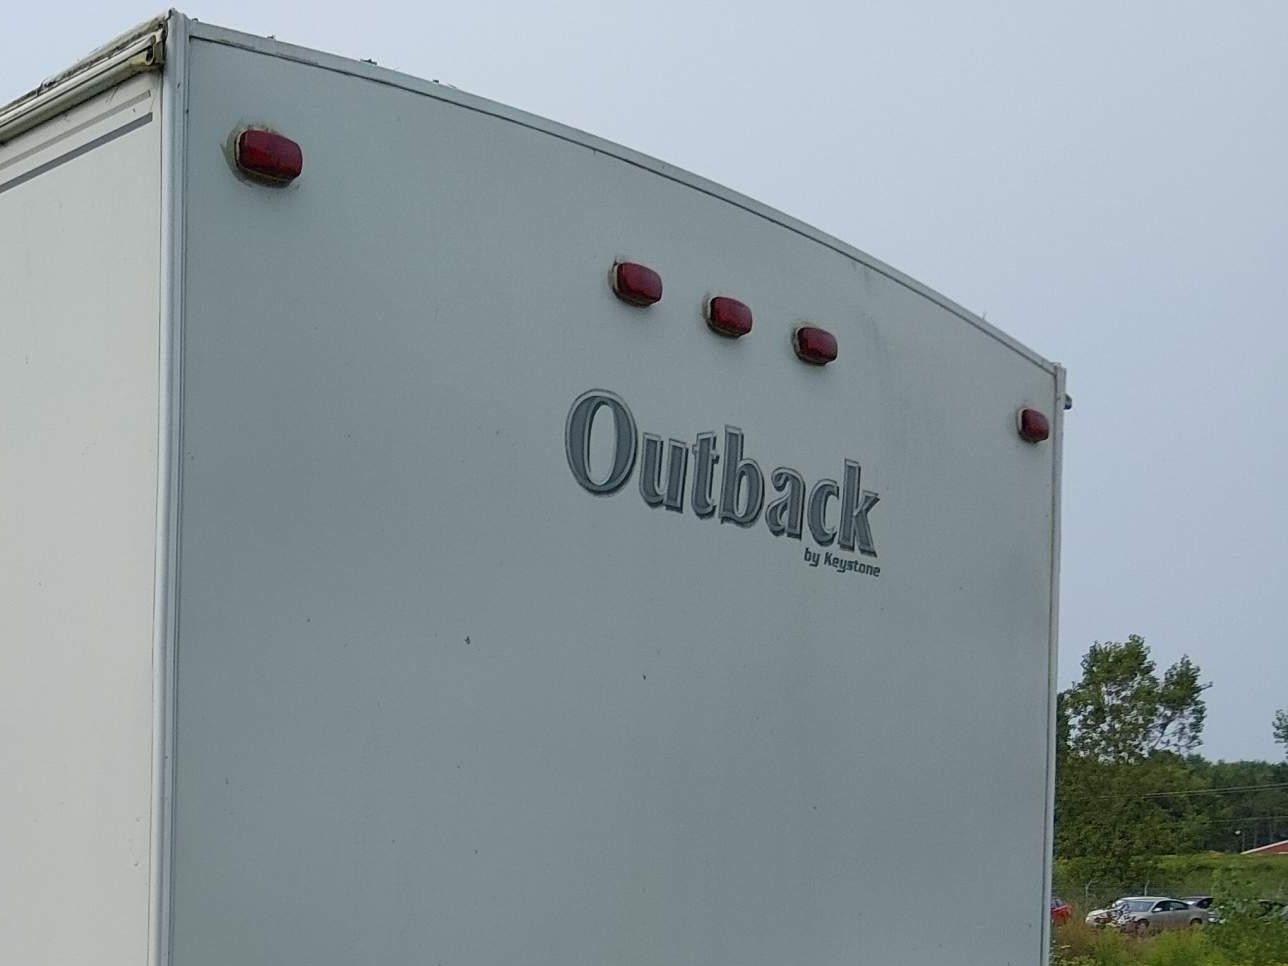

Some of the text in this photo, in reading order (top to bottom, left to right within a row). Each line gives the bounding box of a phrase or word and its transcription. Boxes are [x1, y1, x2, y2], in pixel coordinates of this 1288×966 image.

[565, 388, 880, 557] Outback
[804, 547, 881, 577] by Keystone
